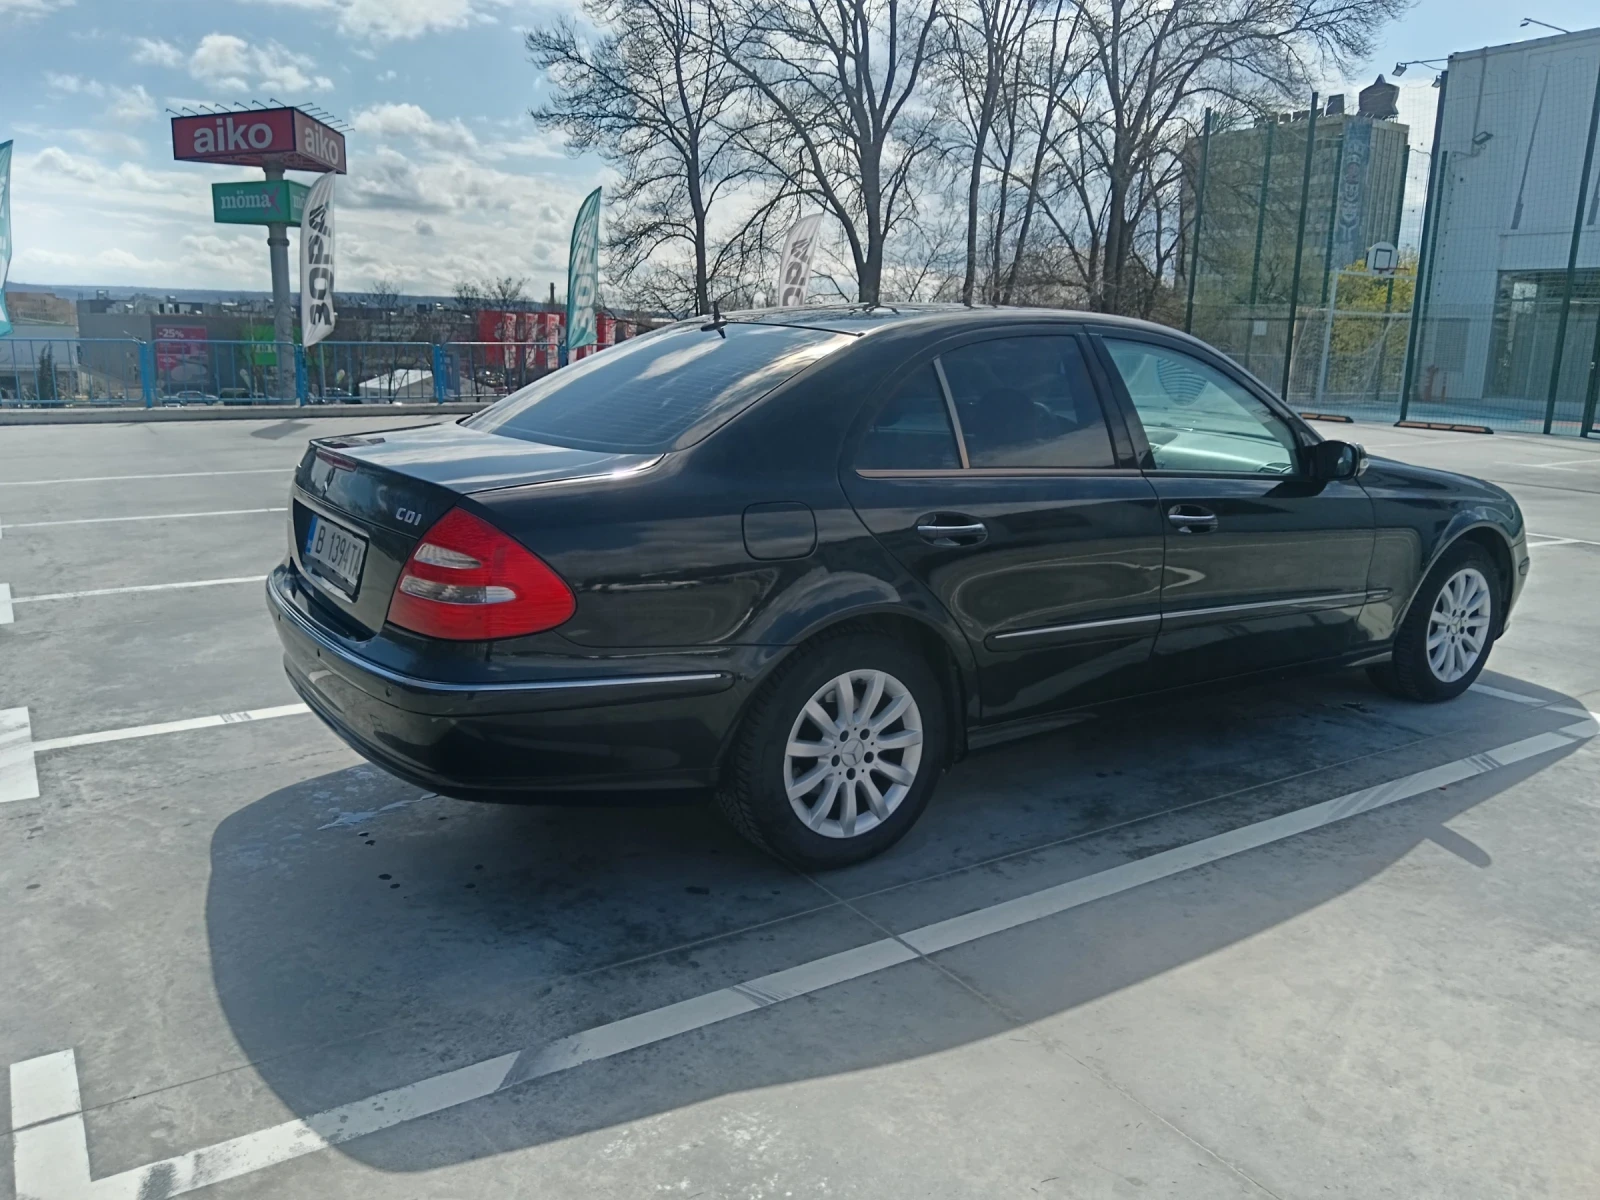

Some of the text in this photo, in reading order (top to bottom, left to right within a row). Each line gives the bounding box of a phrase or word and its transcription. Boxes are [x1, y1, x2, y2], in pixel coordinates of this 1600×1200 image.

[193, 117, 273, 153] aiko
[304, 124, 339, 165] aiko
[395, 507, 422, 526] CDI
